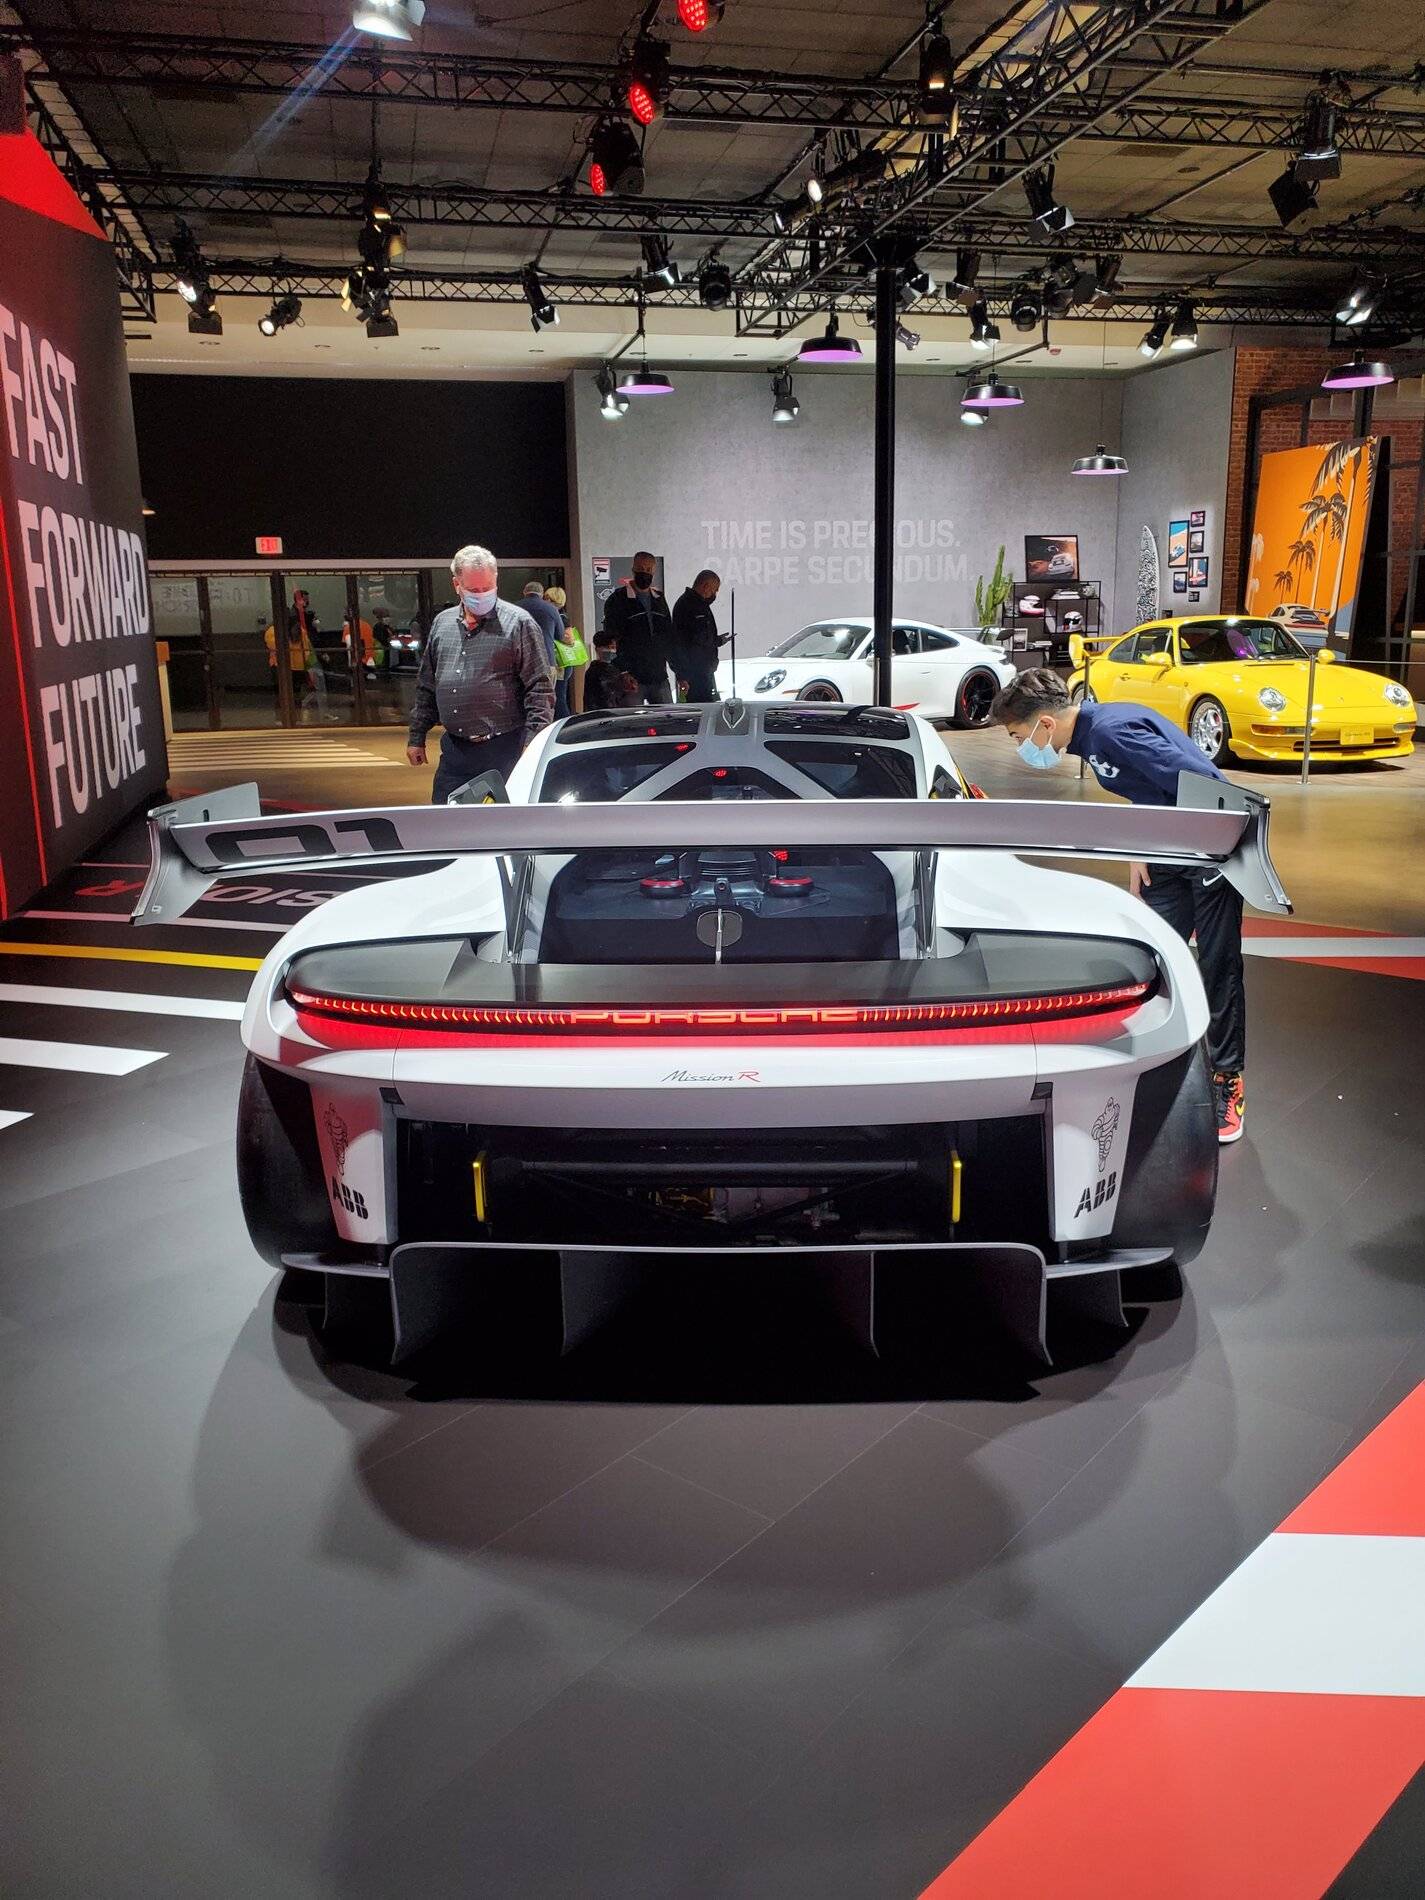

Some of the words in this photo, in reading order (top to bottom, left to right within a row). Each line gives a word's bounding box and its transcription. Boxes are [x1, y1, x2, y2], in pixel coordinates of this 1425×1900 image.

[0, 304, 83, 485] FAST
[701, 520, 772, 550] TIME
[780, 520, 807, 550] IS
[813, 519, 961, 549] PREOUS.
[17, 500, 149, 648] FORWARD
[40, 664, 146, 829] FUTURE
[570, 1009, 859, 1025] PORSCHE
[660, 1070, 735, 1083] Mission
[738, 1071, 761, 1083] R
[332, 1176, 370, 1220] ABB
[1073, 1171, 1118, 1219] ABB
